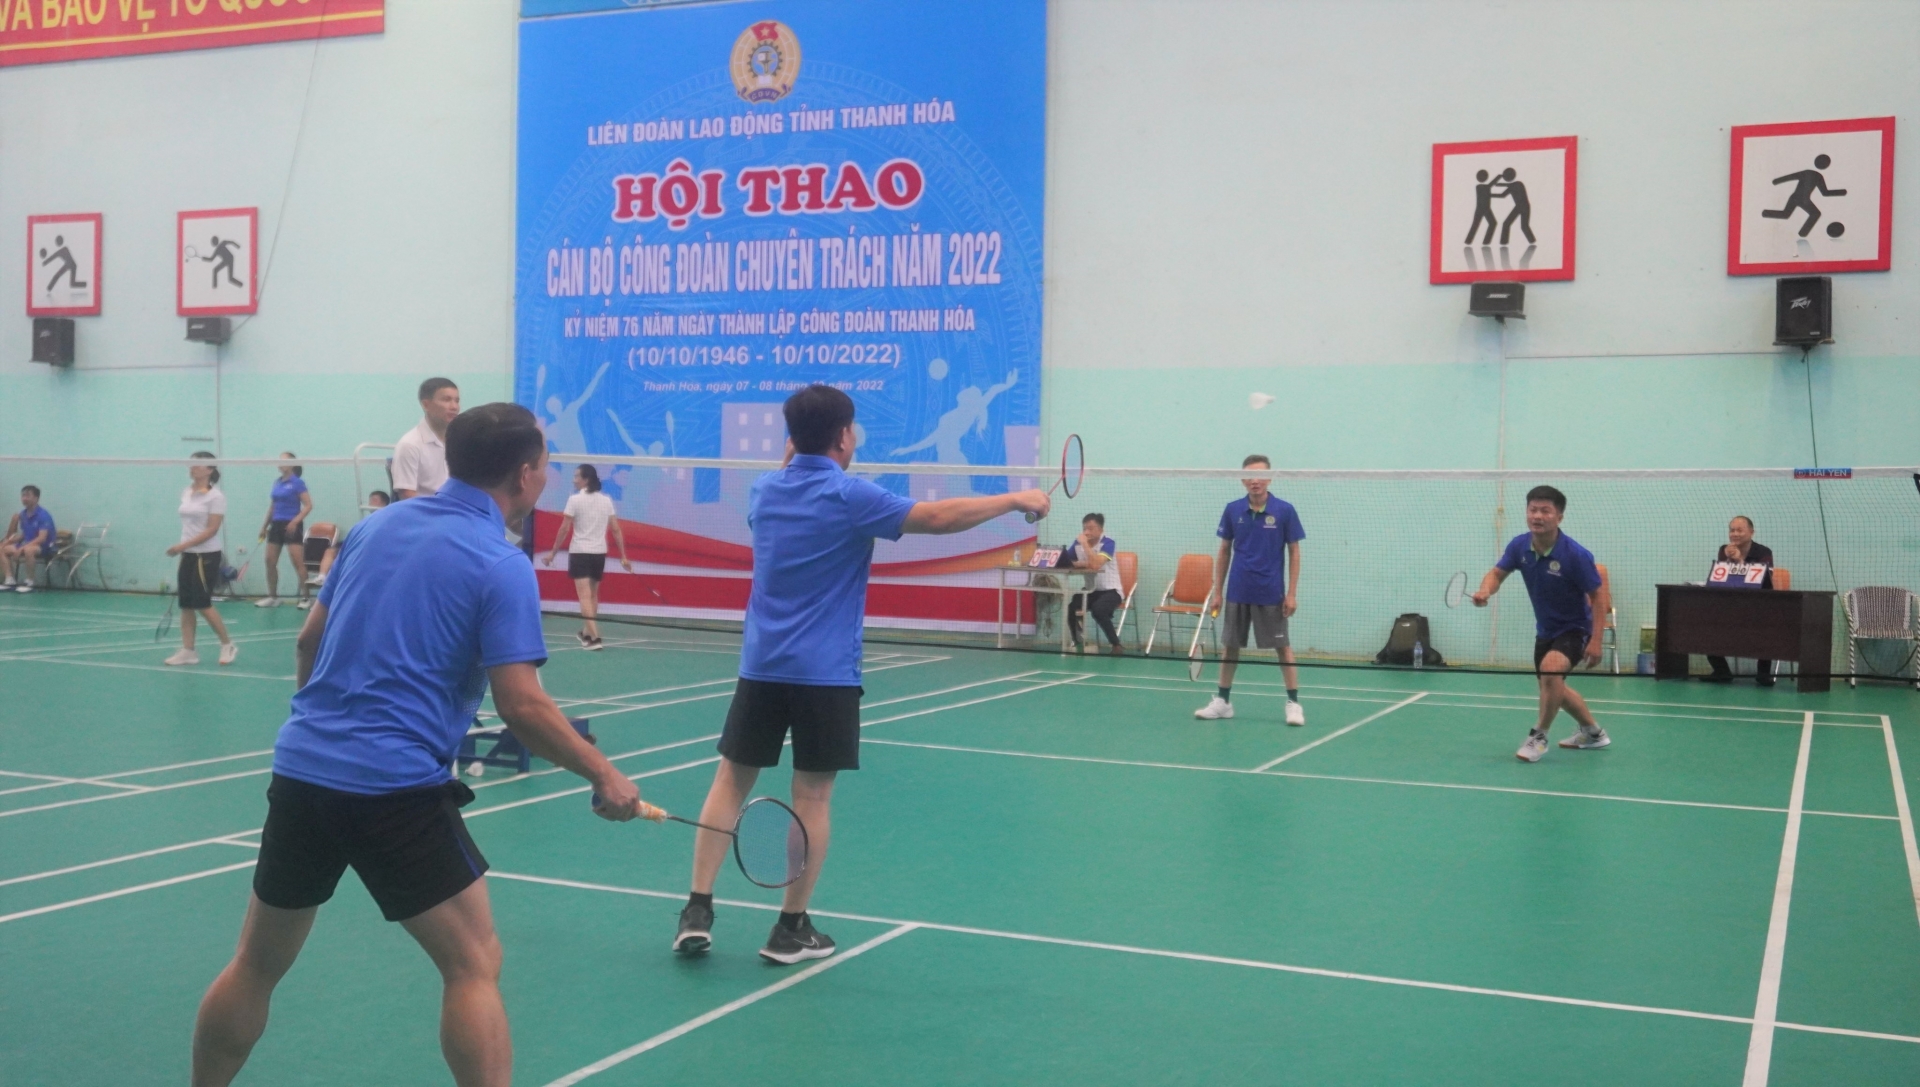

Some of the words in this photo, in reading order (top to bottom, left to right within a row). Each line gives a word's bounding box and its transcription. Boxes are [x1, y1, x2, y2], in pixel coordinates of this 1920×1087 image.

[587, 120, 628, 146] LIÊN
[632, 117, 684, 143] ĐOÀN
[689, 117, 724, 139] LAO
[730, 110, 783, 140] ĐỘNG
[789, 103, 834, 132] TỈNH
[840, 103, 907, 129] THANH
[913, 97, 956, 124] HÓA
[612, 157, 725, 231] HỘI
[736, 158, 923, 214] THAO
[547, 237, 584, 298] CÁN
[589, 235, 614, 307] BỘ
[619, 234, 671, 296] CÔNG
[675, 231, 729, 294] ĐOÀN
[735, 227, 813, 293] CHUYÊN
[819, 225, 886, 289] TRÁCH
[892, 222, 942, 287] NĂM
[947, 231, 1001, 286] 2022
[564, 308, 581, 338] KỶ
[584, 313, 619, 342] NIỆM
[622, 317, 639, 336] 76
[642, 312, 674, 337] NĂM
[678, 310, 715, 336] NGÀY
[719, 309, 765, 335] THÀNH
[768, 308, 796, 339] LẬP
[800, 307, 840, 334] CÔNG
[844, 306, 885, 333] ĐOÀN
[889, 309, 940, 332] THANH
[943, 304, 976, 331] HÓA
[628, 345, 749, 371] (10/10/1946
[771, 343, 901, 369] 10/10/2022)
[643, 381, 676, 392] Thanh
[735, 381, 749, 391] 07
[758, 381, 773, 391] 08
[856, 380, 884, 391] 2022
[1713, 567, 1727, 580] 9
[1750, 568, 1763, 582] 7
